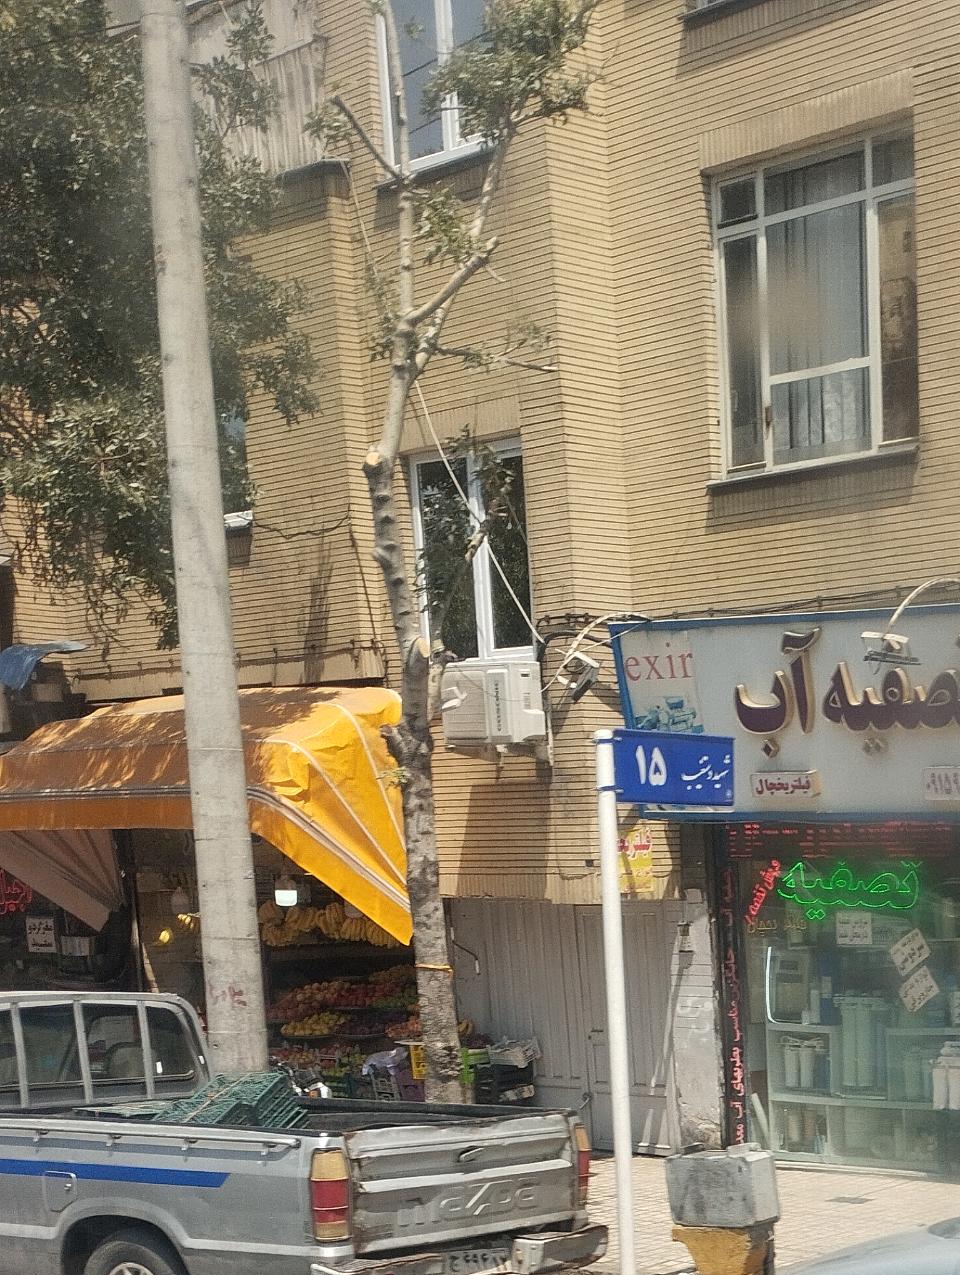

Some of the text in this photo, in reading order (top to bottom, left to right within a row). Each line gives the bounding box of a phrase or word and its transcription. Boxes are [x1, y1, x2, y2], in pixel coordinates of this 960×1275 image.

[625, 642, 693, 682] exir
[735, 626, 822, 758] آب
[635, 744, 667, 786] ۱۵
[755, 775, 811, 796] فیلتر یخچال
[777, 860, 924, 920] تصفیه
